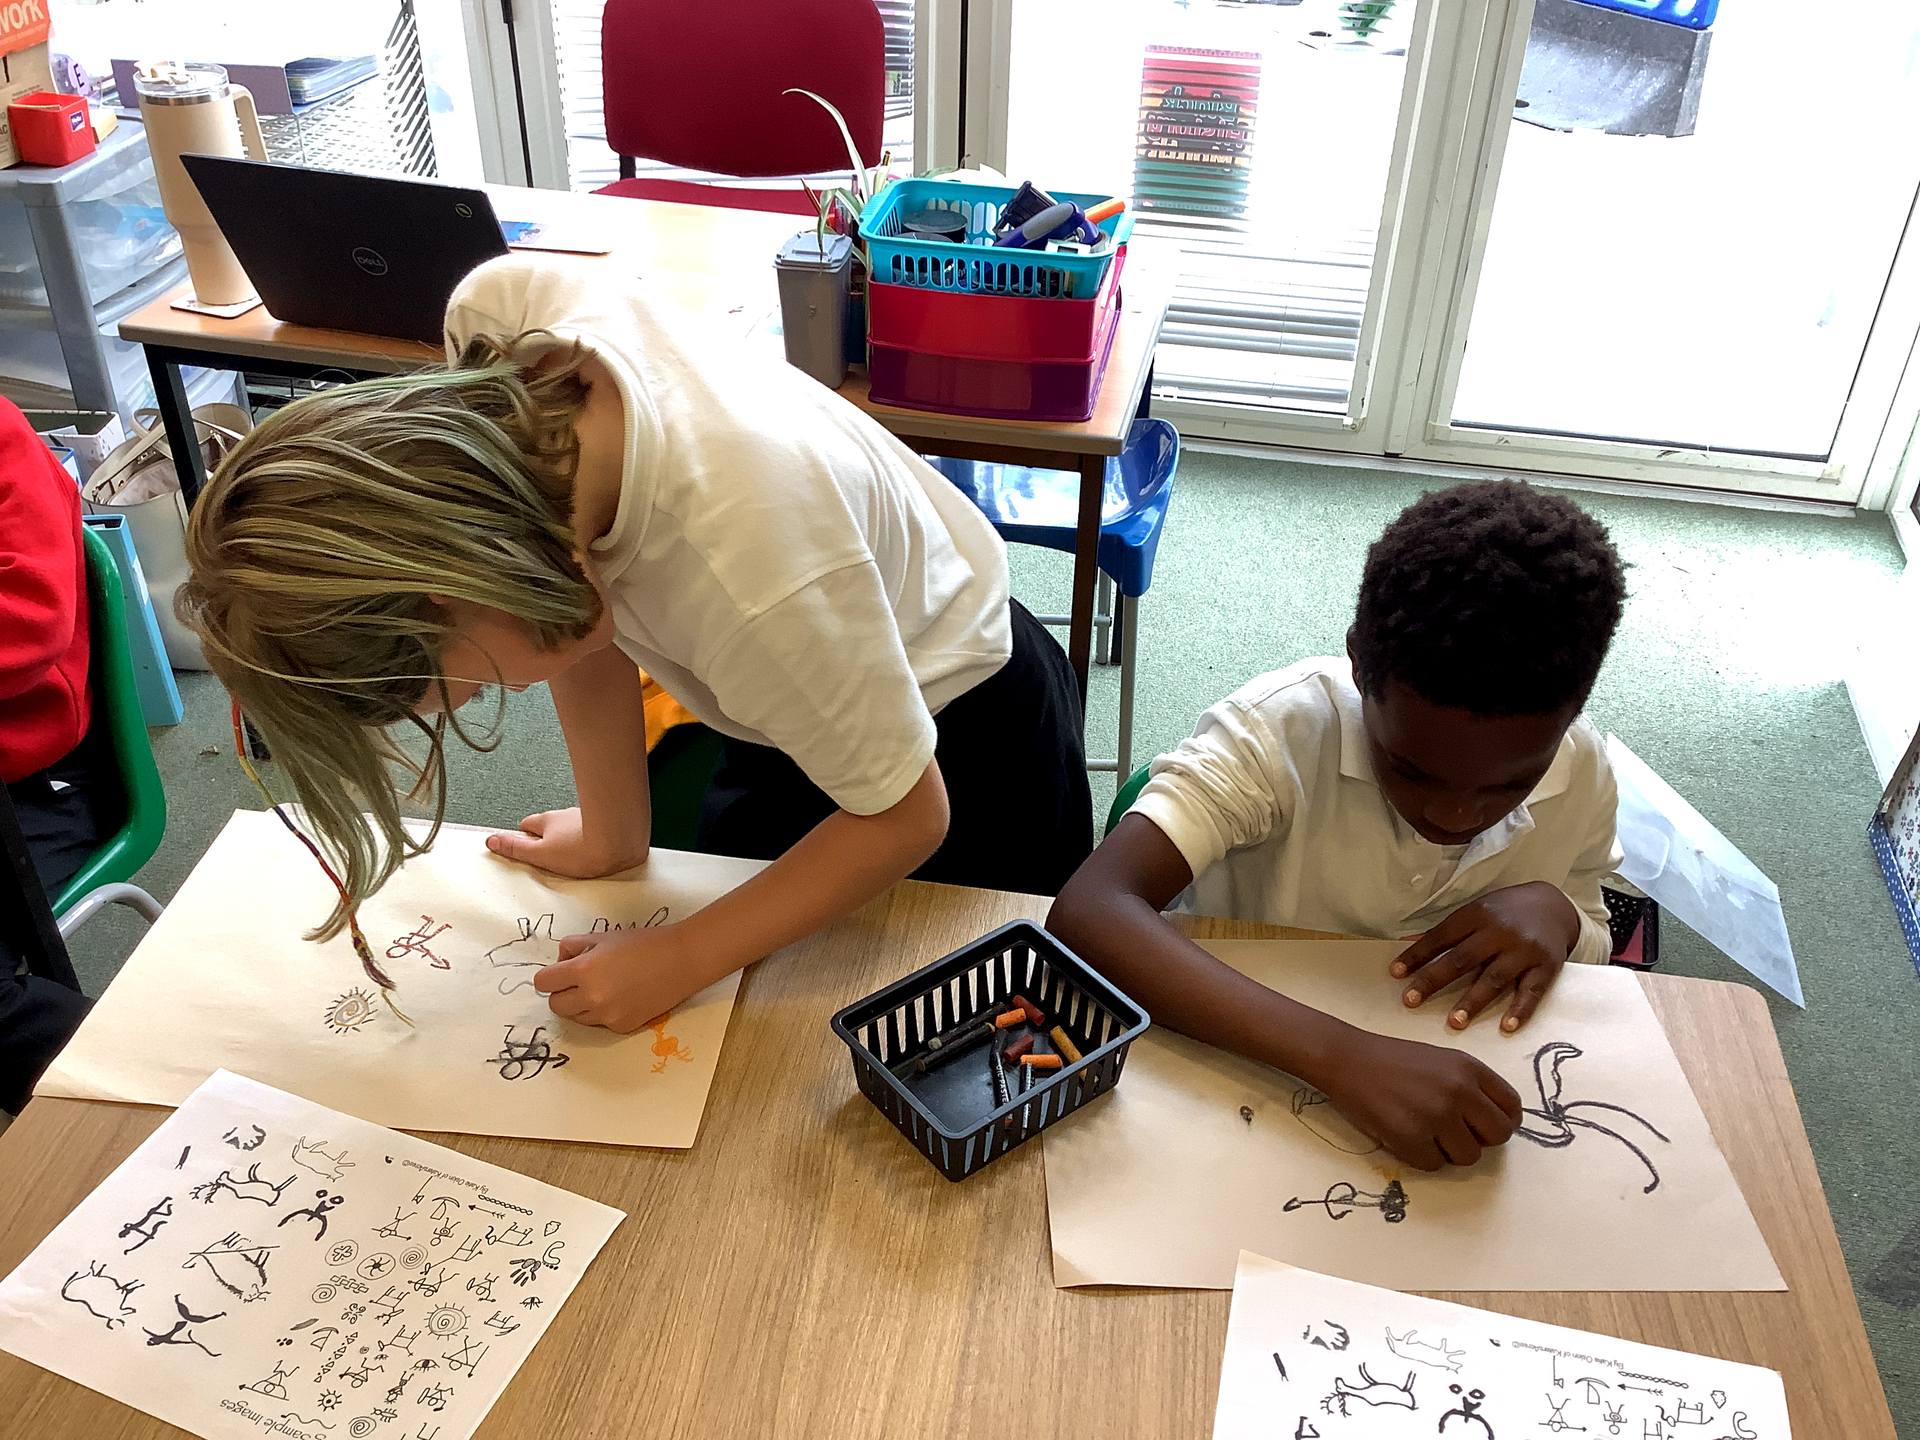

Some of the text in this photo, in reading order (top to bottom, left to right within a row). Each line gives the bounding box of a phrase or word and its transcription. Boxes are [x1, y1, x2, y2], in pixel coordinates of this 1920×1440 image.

[357, 256, 385, 267] DELL
[999, 1079, 1009, 1104] PASTE
[1614, 1360, 1624, 1370] By
[220, 1399, 264, 1425] Images
